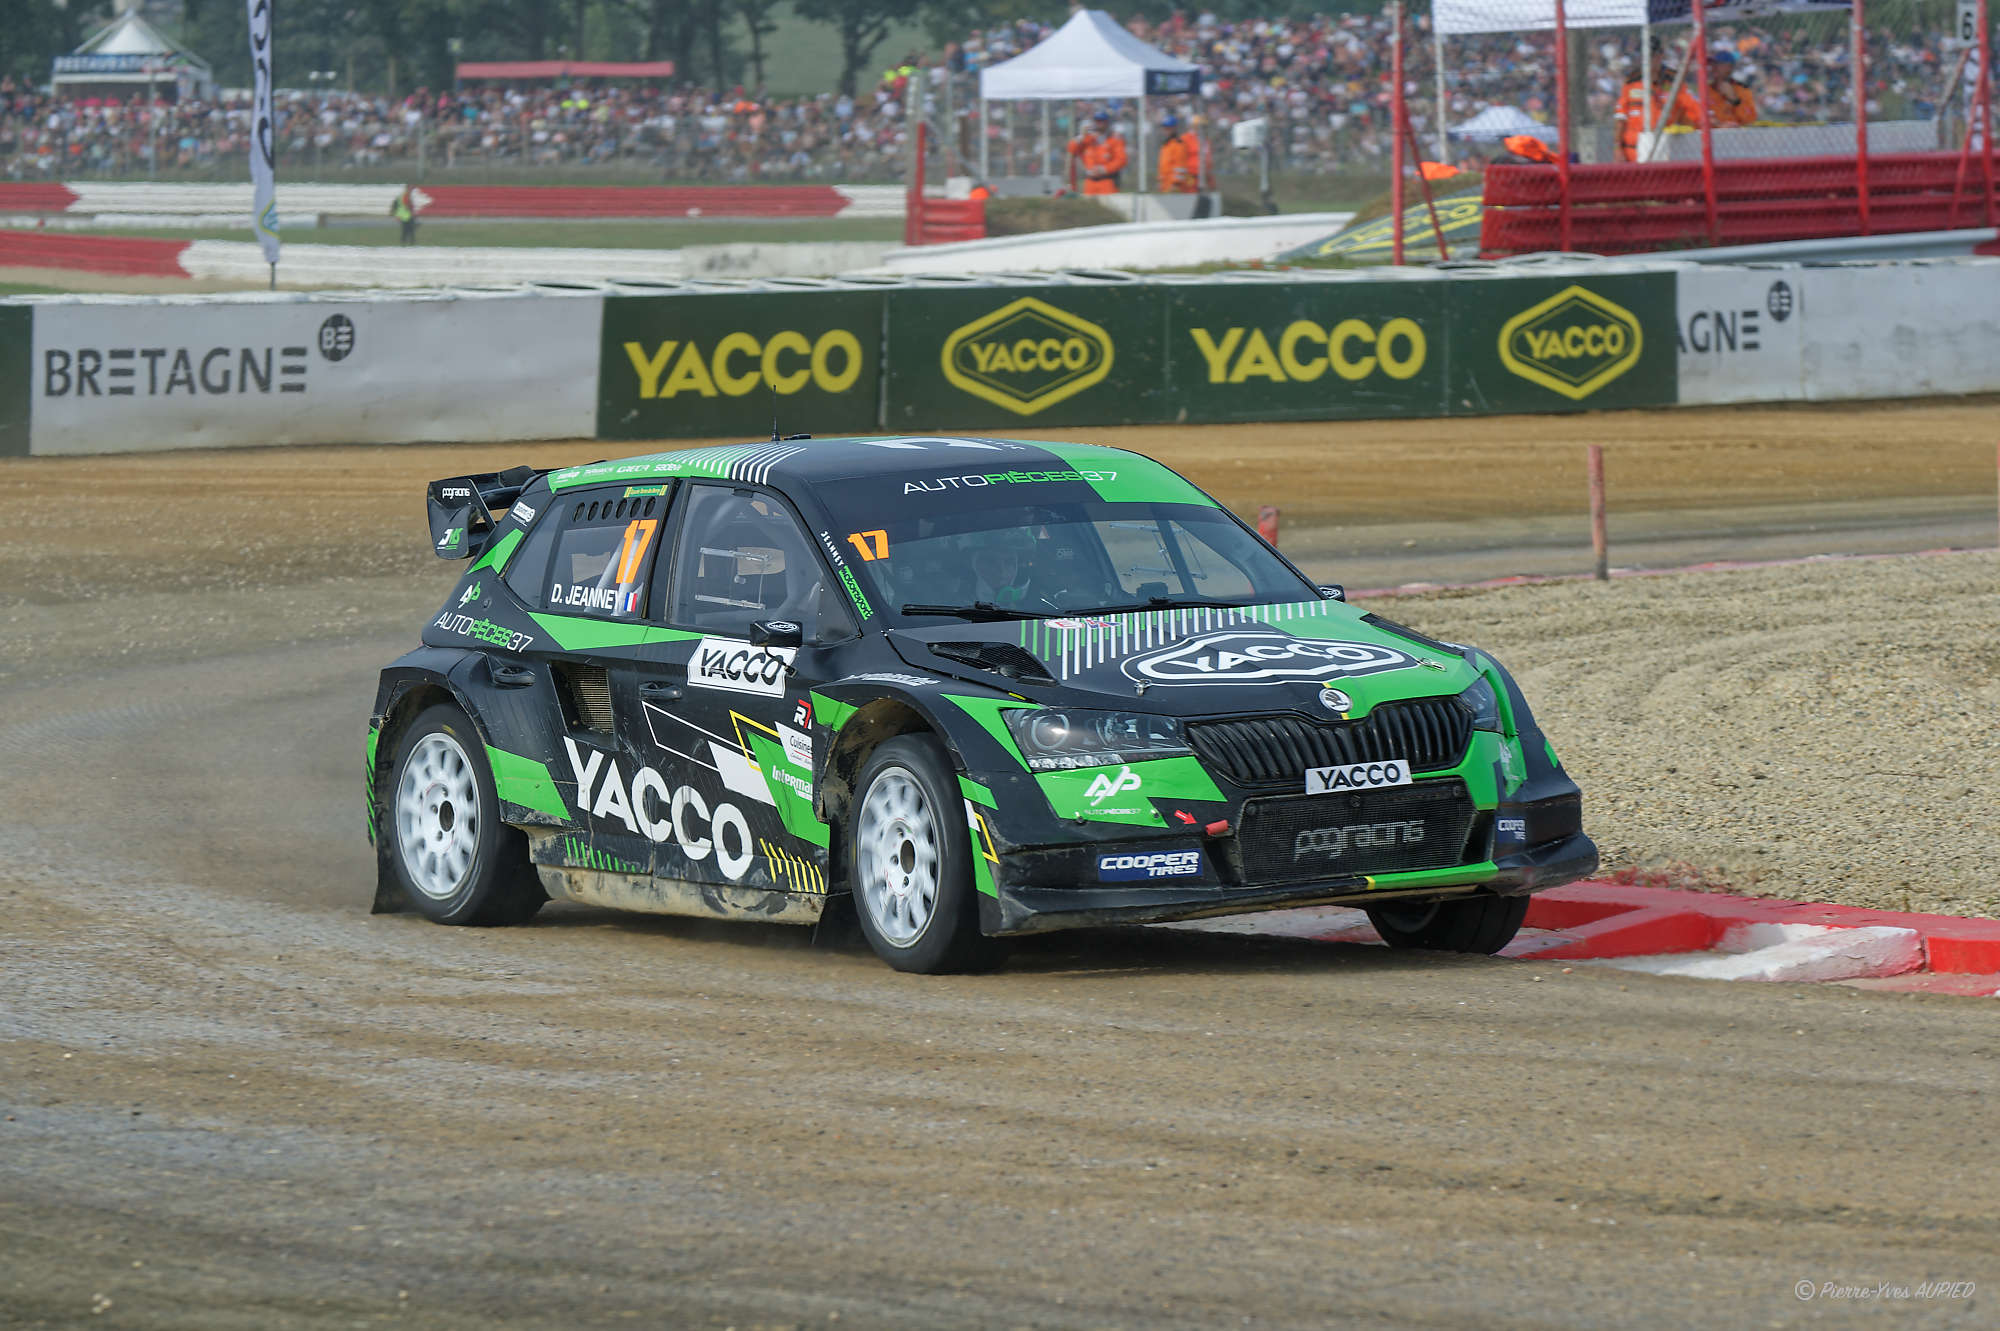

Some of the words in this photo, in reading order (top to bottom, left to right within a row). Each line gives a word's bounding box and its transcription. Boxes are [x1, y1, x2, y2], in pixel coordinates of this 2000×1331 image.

[1962, 12, 1975, 40] 6
[970, 338, 1089, 372] YACCO
[1189, 318, 1427, 383] YACCO
[1524, 324, 1625, 359] YACCO
[44, 347, 307, 397] BRETAGNE
[623, 329, 862, 399] YACCO
[903, 470, 1118, 494] AUTOPIÈCES37
[616, 519, 658, 584] 17
[820, 531, 844, 567] JEANNEY
[847, 530, 889, 561] 17
[551, 584, 562, 603] D.
[565, 586, 621, 610] JEANNEY
[701, 648, 784, 686] YACCO
[1166, 643, 1375, 672] YACCO
[1317, 763, 1400, 790] YACCO
[563, 736, 754, 880] YACCO
[1101, 852, 1199, 870] COOPER
[1147, 865, 1198, 877] TIRES
